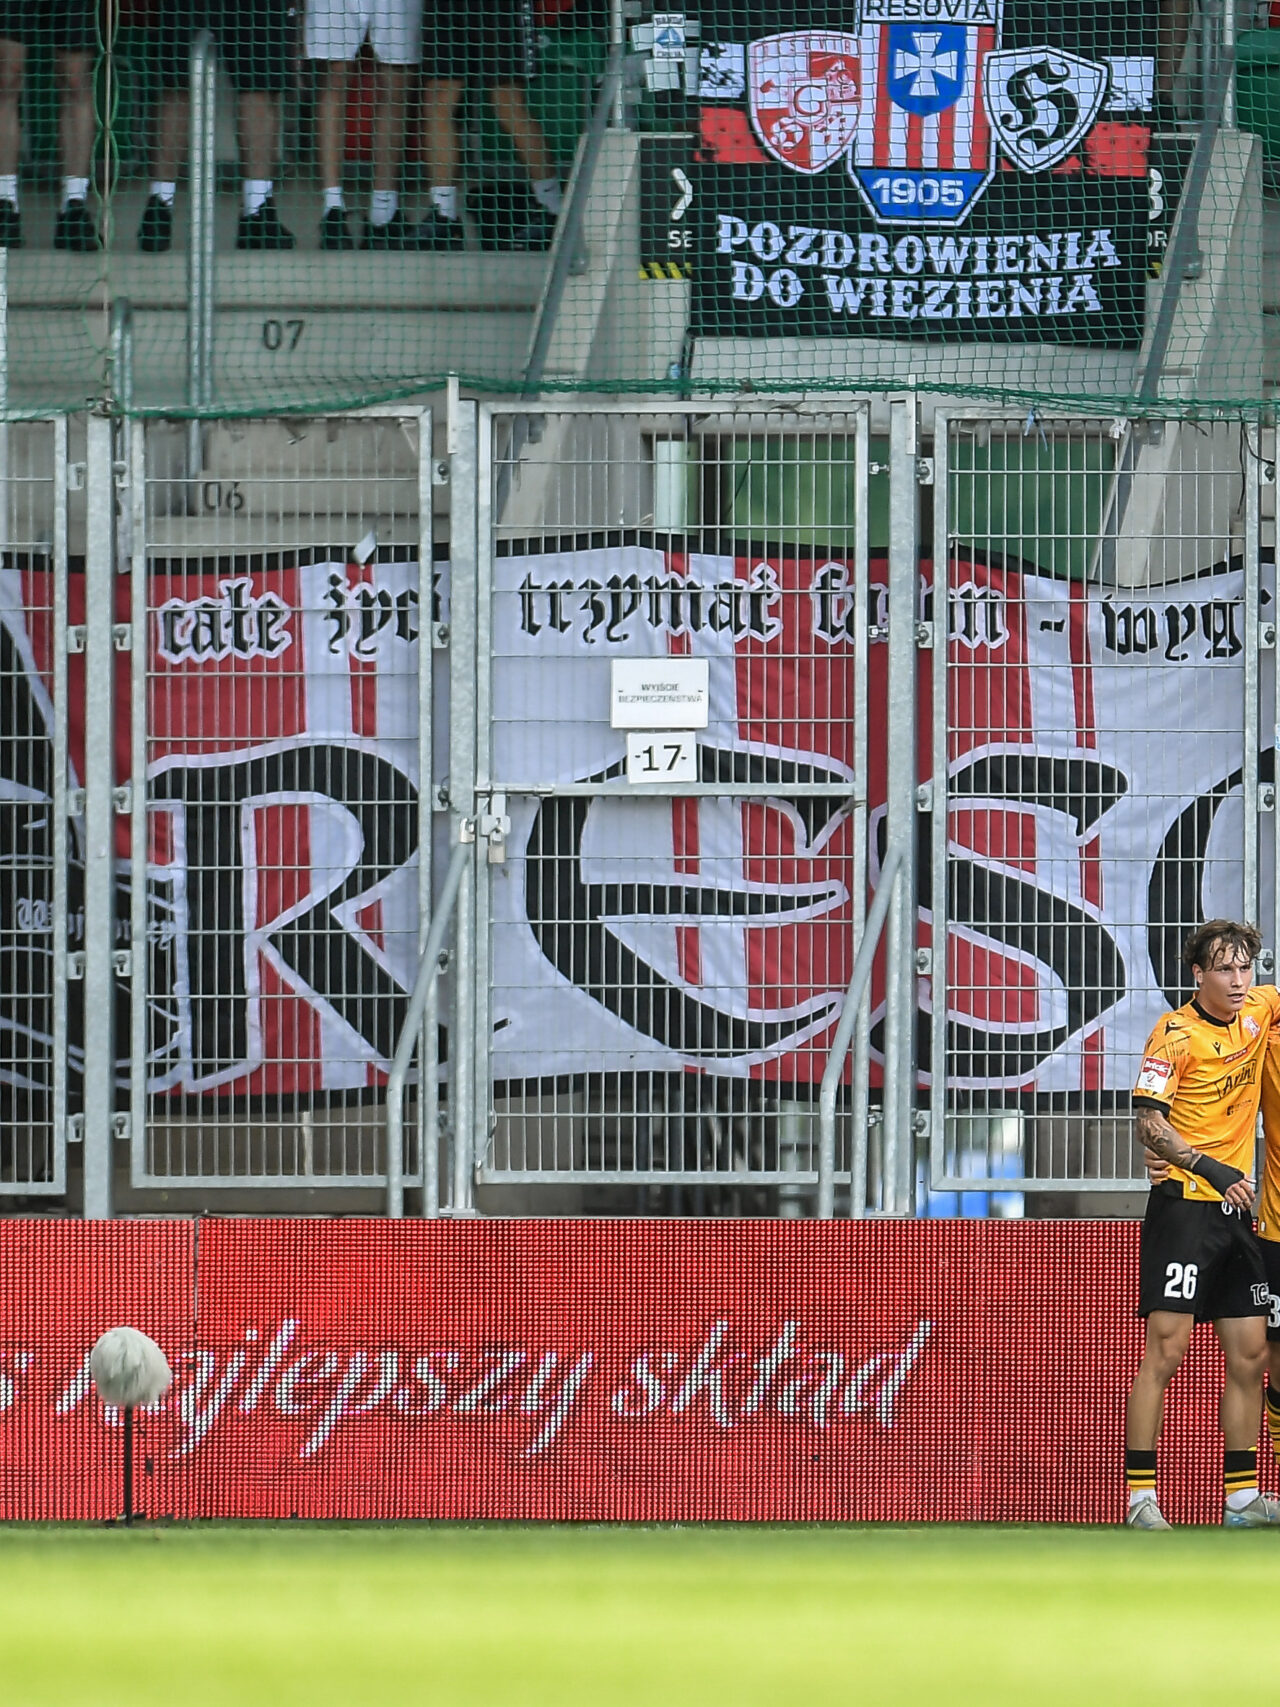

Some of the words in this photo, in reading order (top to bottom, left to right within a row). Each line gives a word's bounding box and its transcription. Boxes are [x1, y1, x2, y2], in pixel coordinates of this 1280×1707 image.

[865, 0, 993, 20] RESOVIA
[870, 177, 965, 207] 1905
[716, 214, 1122, 275] POZDROWIENIA
[731, 260, 805, 307] DO
[263, 319, 305, 351] 07
[204, 480, 244, 511] 06
[642, 744, 683, 772] 17
[1222, 1062, 1256, 1096] Arini
[1164, 1262, 1200, 1300] 26
[610, 1319, 933, 1428] skład
